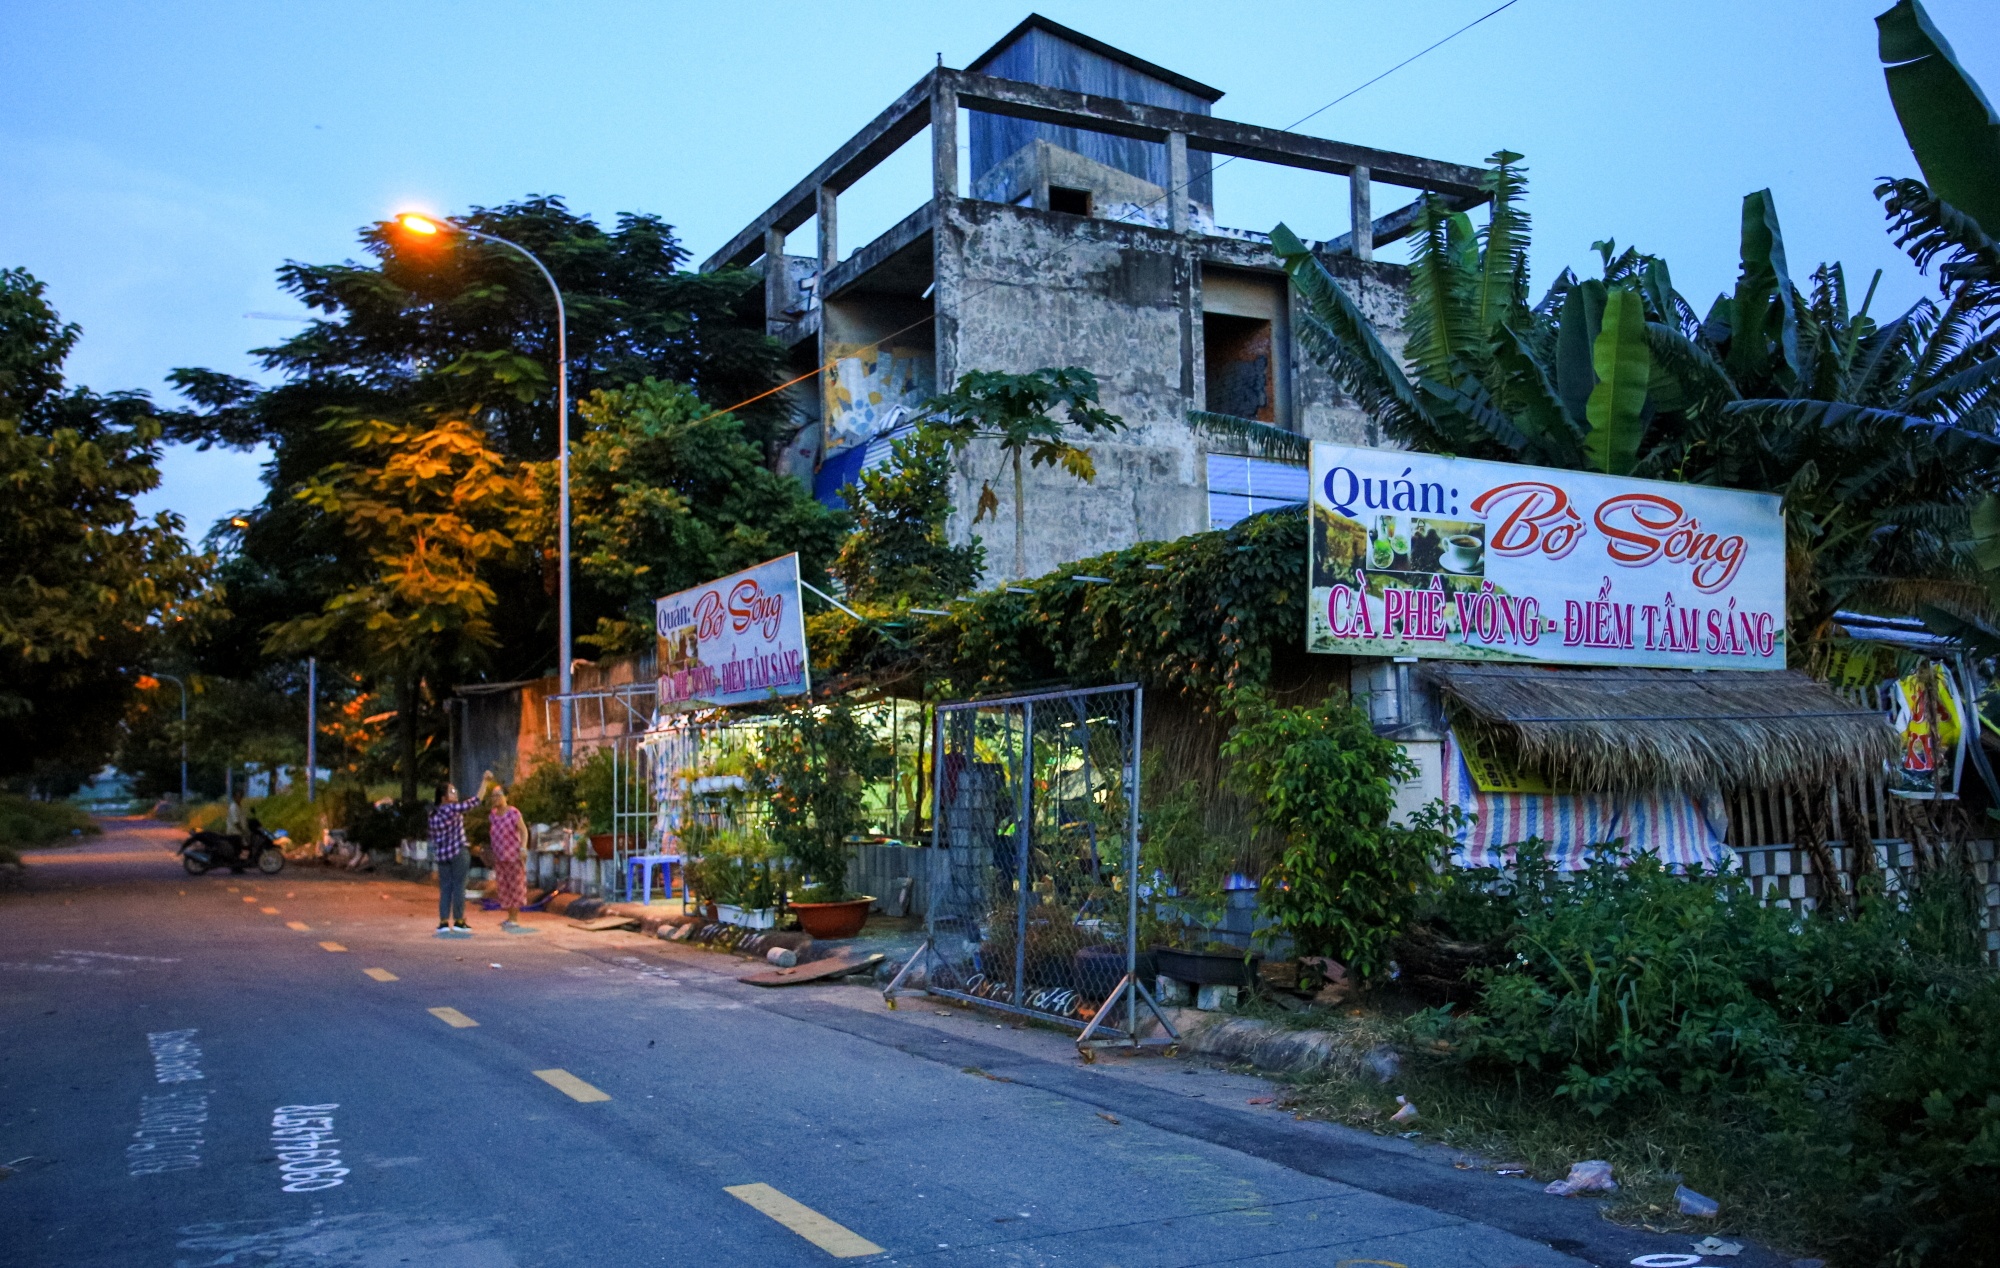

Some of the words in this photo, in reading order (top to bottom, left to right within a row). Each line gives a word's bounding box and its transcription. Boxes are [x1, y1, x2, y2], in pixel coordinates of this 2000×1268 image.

[1323, 466, 1459, 518] Quán:
[1469, 481, 1587, 561] Bờ
[1593, 493, 1749, 596] Sông
[658, 600, 691, 637] Quán:
[728, 578, 783, 643] Sông
[1327, 568, 1378, 639] CÀ
[1382, 573, 1449, 642] PHÊ
[1453, 578, 1541, 646] VÕNG
[1562, 575, 1636, 650] ĐIỂM
[1641, 590, 1701, 653] TÂM
[1705, 595, 1775, 657] SÁNG
[747, 645, 770, 691] TÂM
[770, 640, 801, 688] SÁNG
